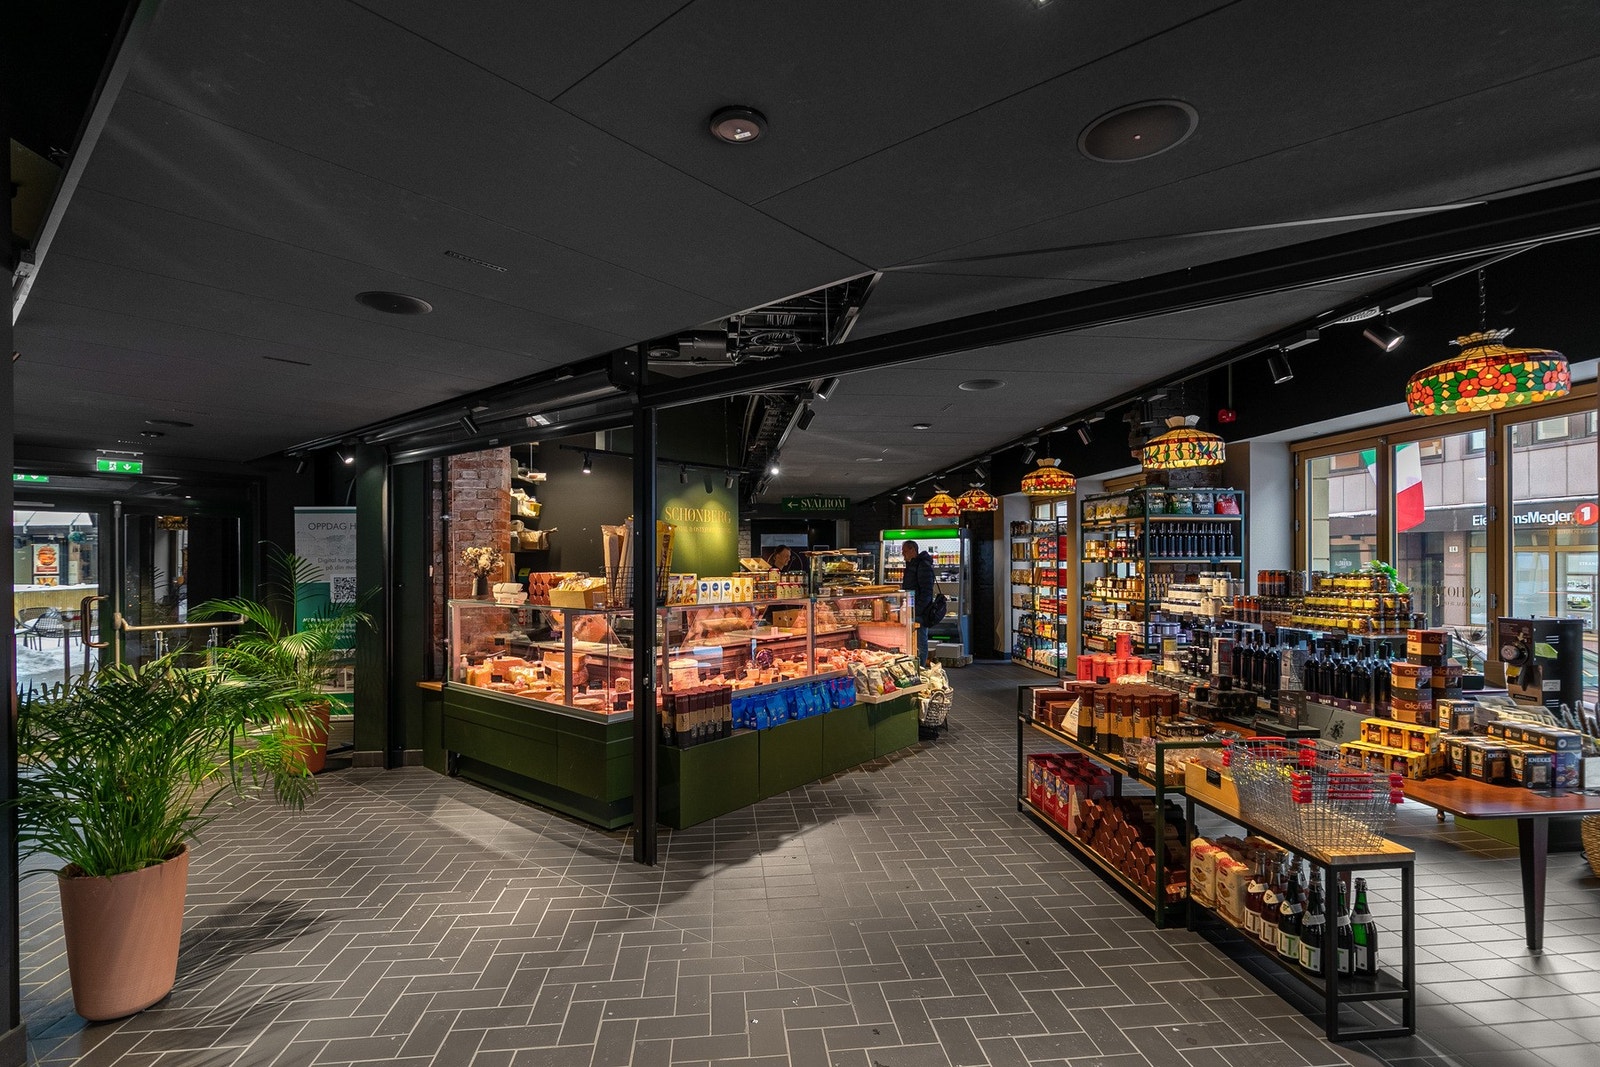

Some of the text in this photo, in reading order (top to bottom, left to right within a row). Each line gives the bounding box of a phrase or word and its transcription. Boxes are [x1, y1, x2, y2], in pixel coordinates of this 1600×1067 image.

[801, 499, 846, 508] SVALROM
[665, 507, 731, 524] SCHØNBERG
[308, 522, 347, 530] OPPDAG
